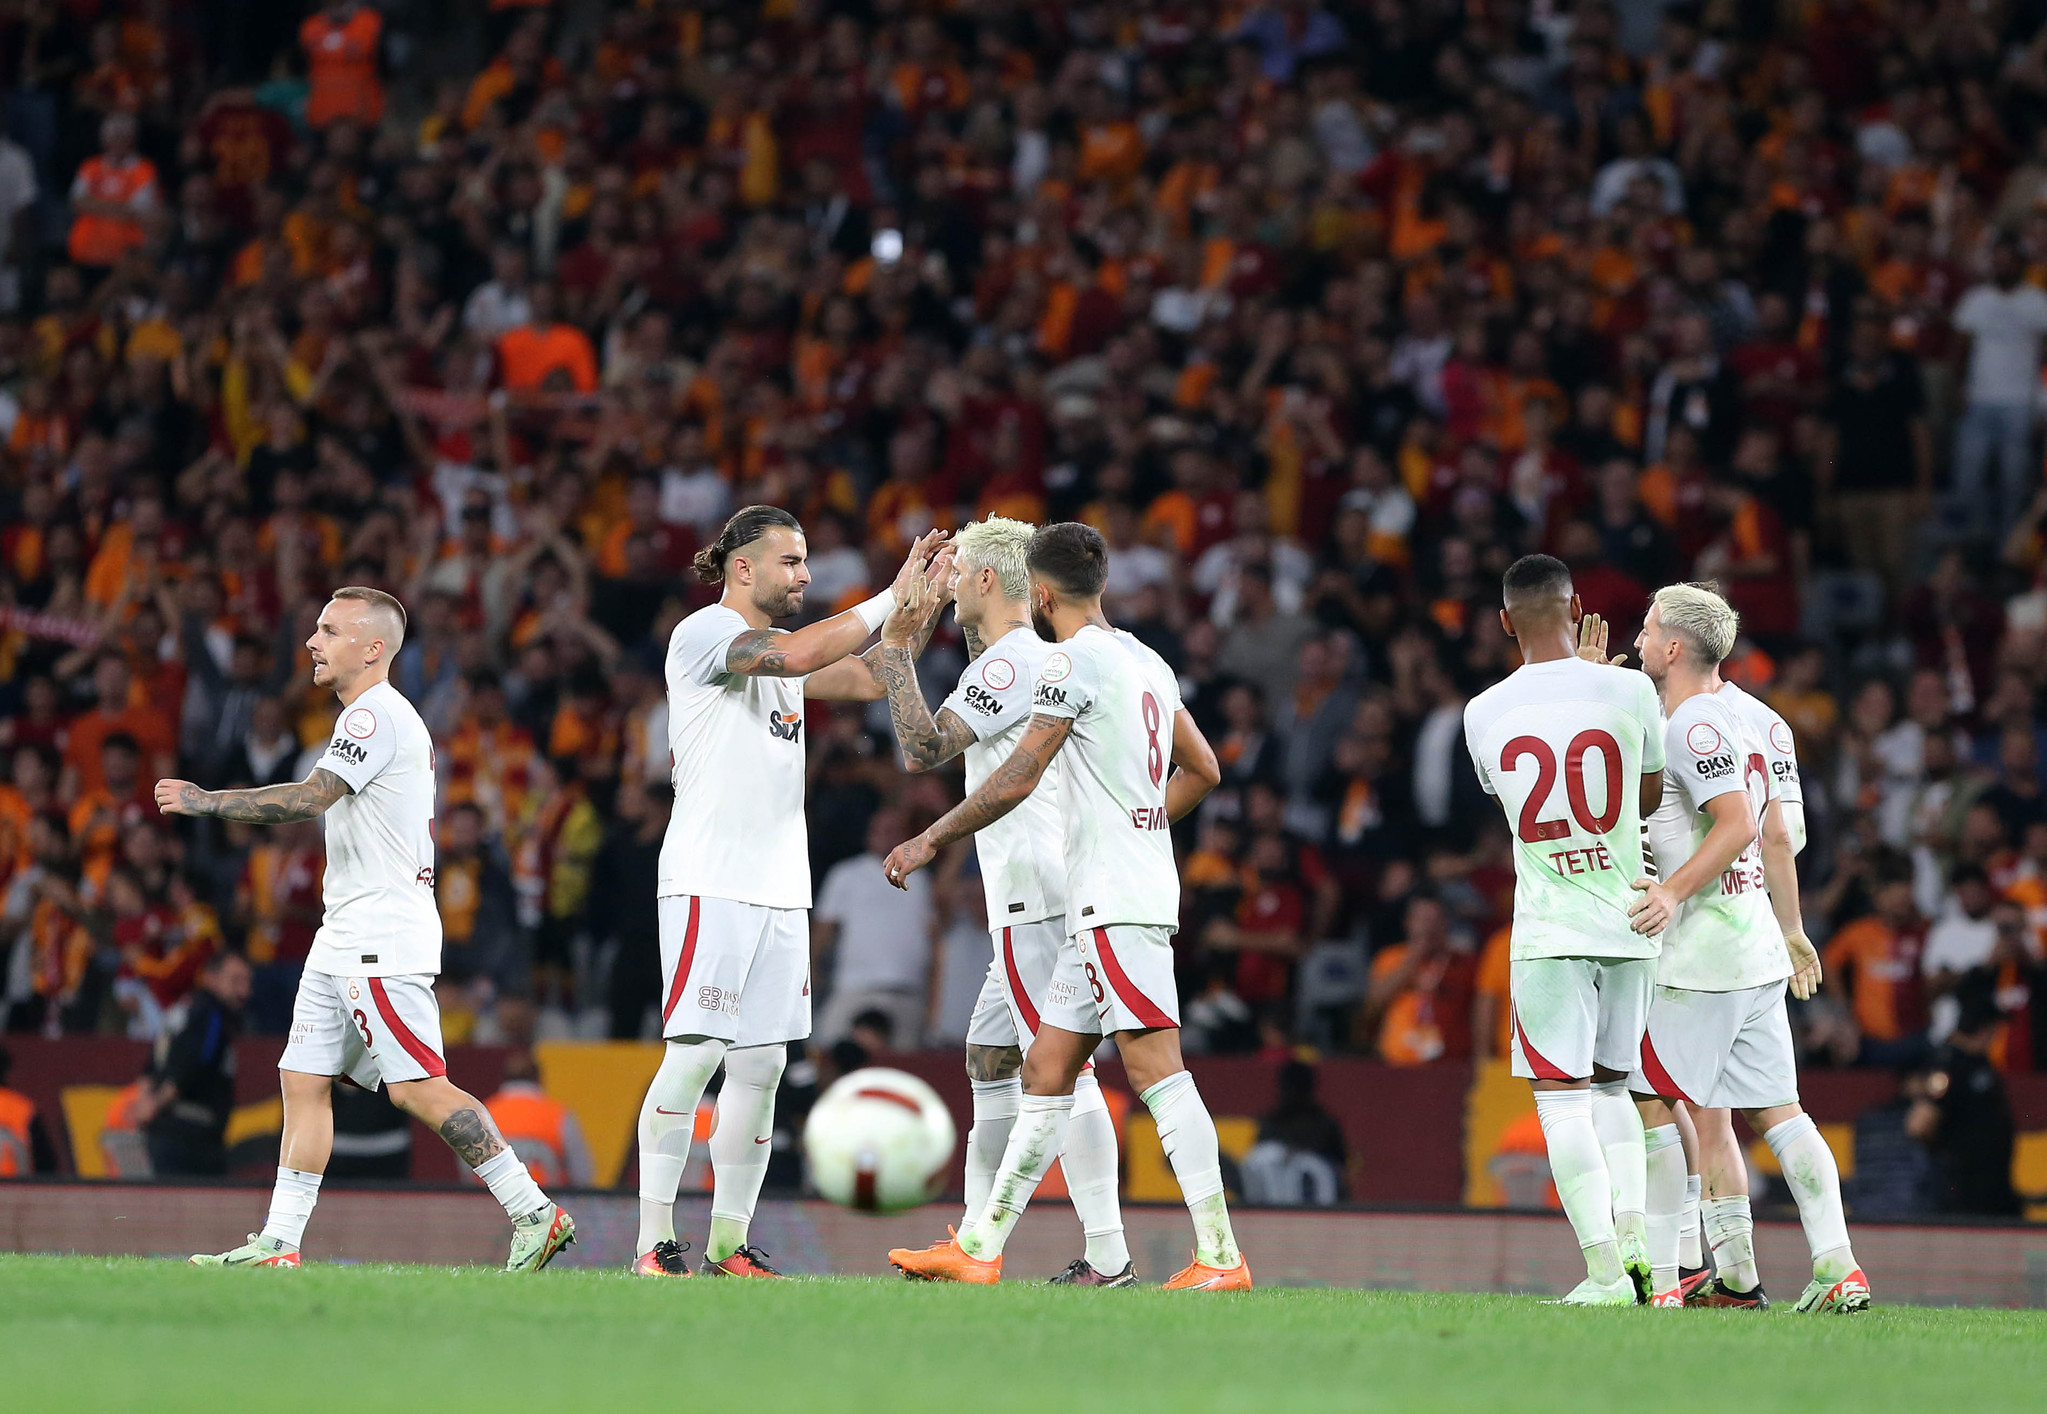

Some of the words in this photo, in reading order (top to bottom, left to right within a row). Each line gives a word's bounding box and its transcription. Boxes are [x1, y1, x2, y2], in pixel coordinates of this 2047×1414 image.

[964, 696, 991, 717] KARGO
[966, 685, 1003, 715] GKN
[1142, 691, 1162, 791] 8
[1696, 755, 1735, 775] GKN
[1704, 767, 1735, 780] KARGO
[1500, 728, 1623, 844] 20
[1549, 841, 1613, 876] TETÊ
[1085, 961, 1105, 1004] 8
[353, 1008, 373, 1048] 3
